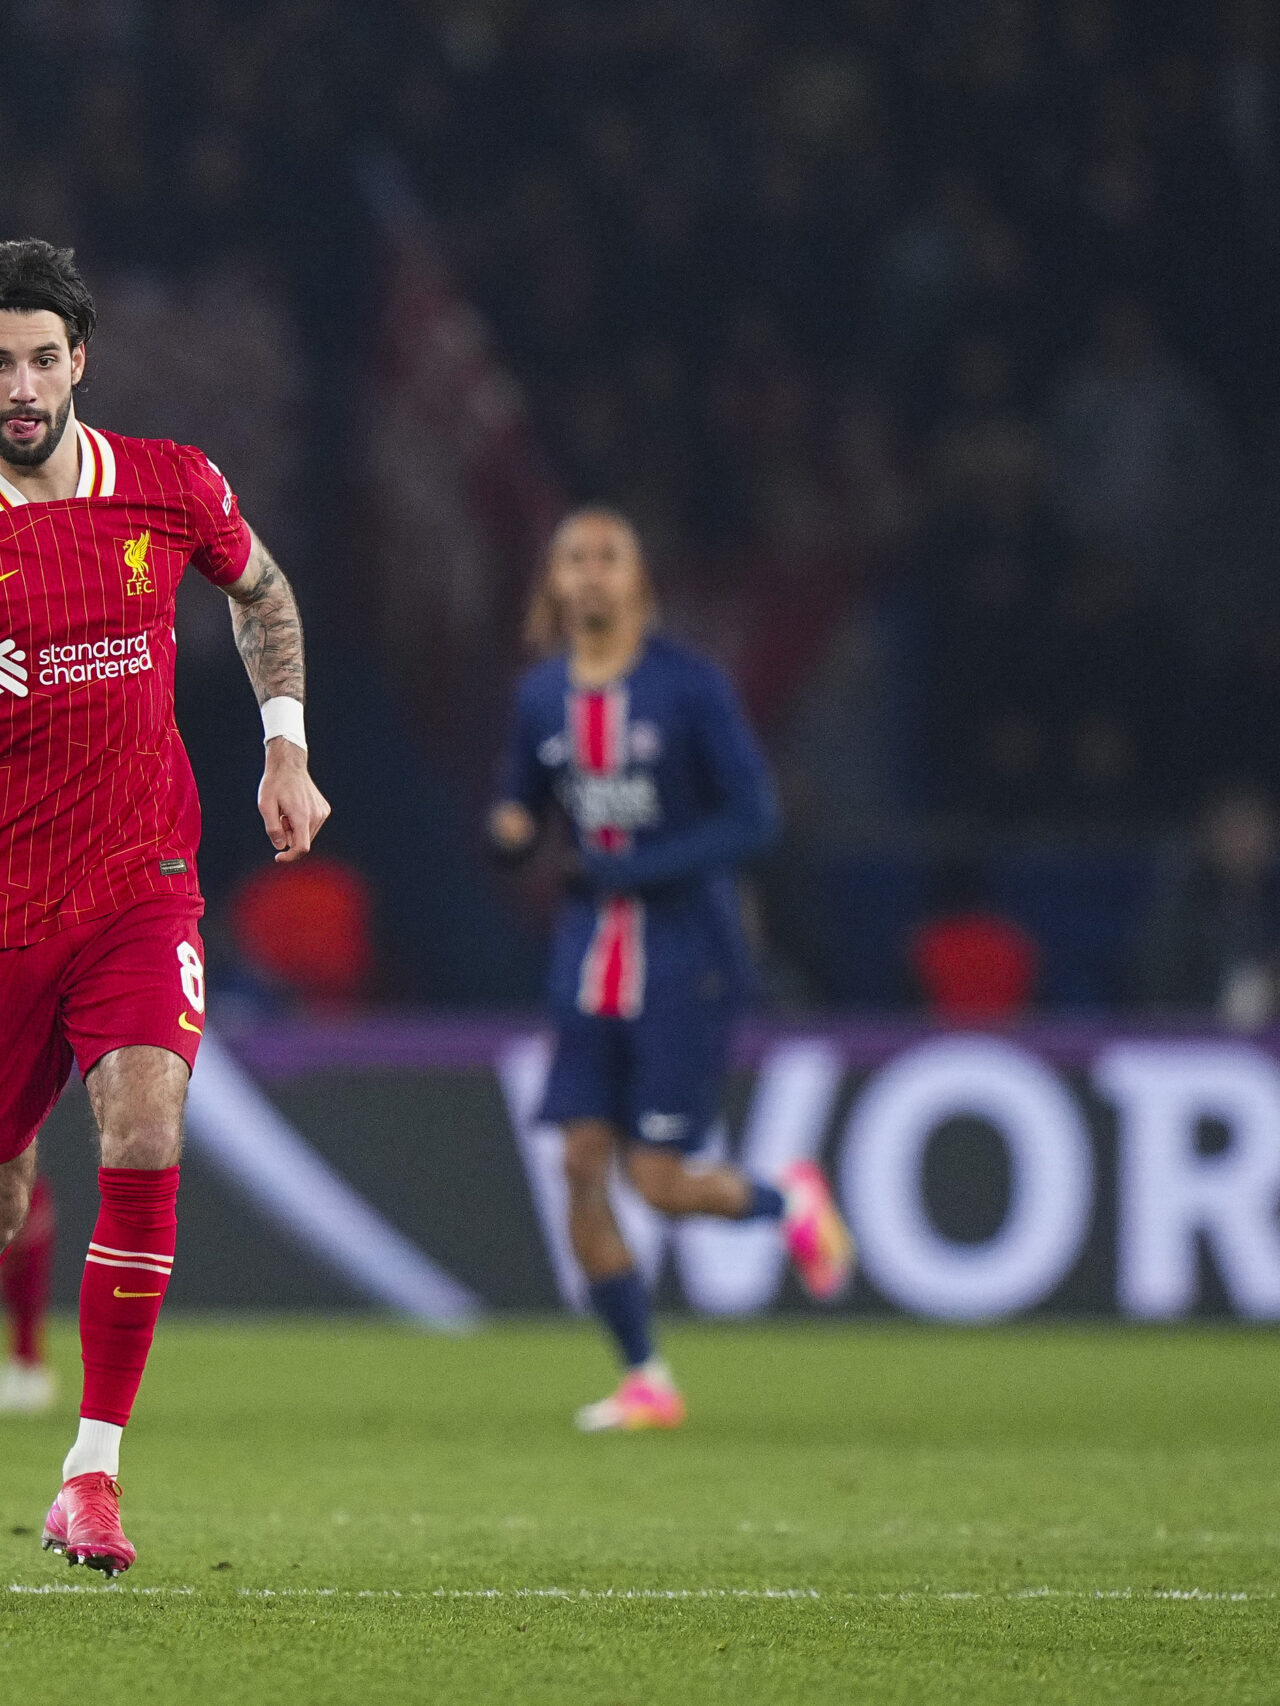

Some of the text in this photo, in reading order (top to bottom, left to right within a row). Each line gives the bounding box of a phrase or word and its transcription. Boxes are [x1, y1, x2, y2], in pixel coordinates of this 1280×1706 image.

[39, 630, 148, 665] standard
[39, 648, 153, 685] chartered
[176, 940, 204, 1015] 8
